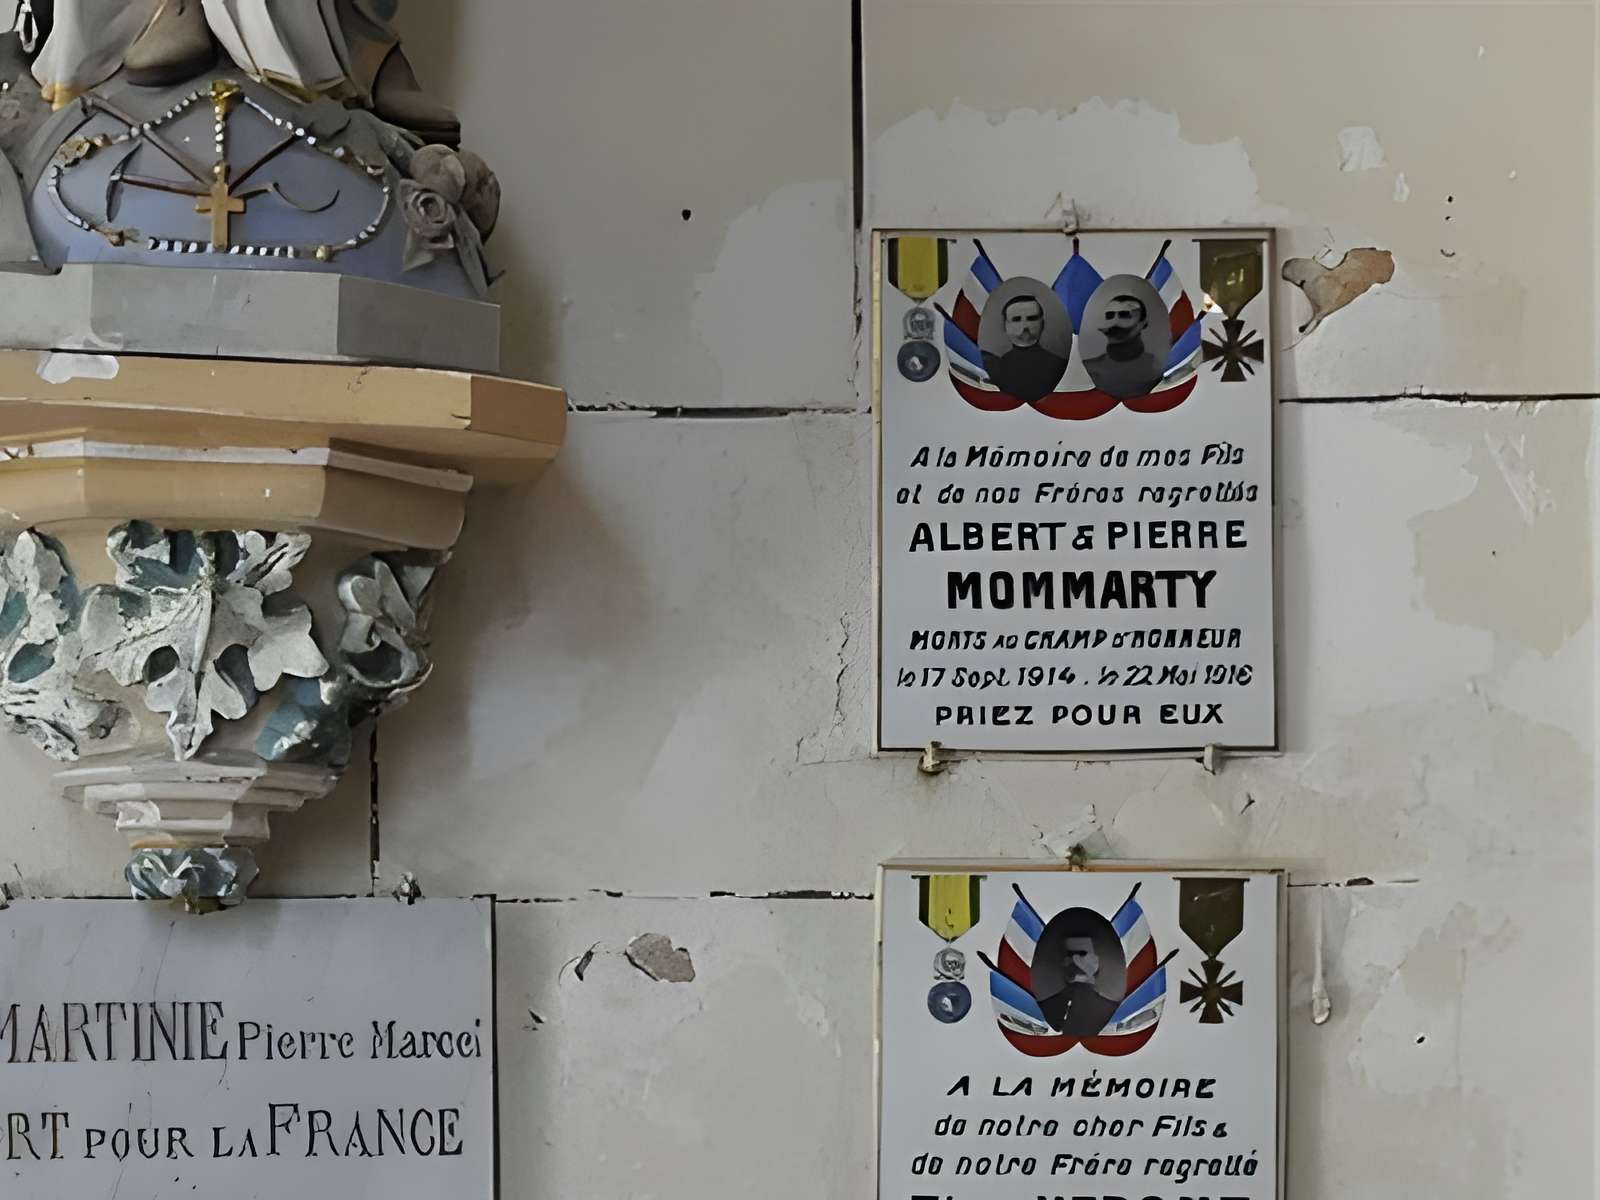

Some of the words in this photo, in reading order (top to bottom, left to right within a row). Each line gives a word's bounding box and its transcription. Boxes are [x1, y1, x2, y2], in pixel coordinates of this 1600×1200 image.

[910, 446, 930, 467] A
[909, 522, 1066, 552] ALBERT
[1072, 525, 1094, 550] &
[1108, 520, 1248, 550] PIERRE
[947, 570, 1217, 610] MOMMARTY
[921, 667, 946, 687] 17
[936, 706, 1033, 726] PRIEZ
[1052, 704, 1141, 726] POUR
[1160, 704, 1224, 724] EUX
[237, 1021, 355, 1060] Pierre
[947, 1076, 970, 1096] A
[992, 1077, 1033, 1096] LA
[1051, 1070, 1216, 1099] MÉMOIRE
[85, 1126, 195, 1162] POUR
[212, 1126, 259, 1158] LA
[266, 1104, 465, 1158] FRANCE
[1152, 1115, 1206, 1137] Fils
